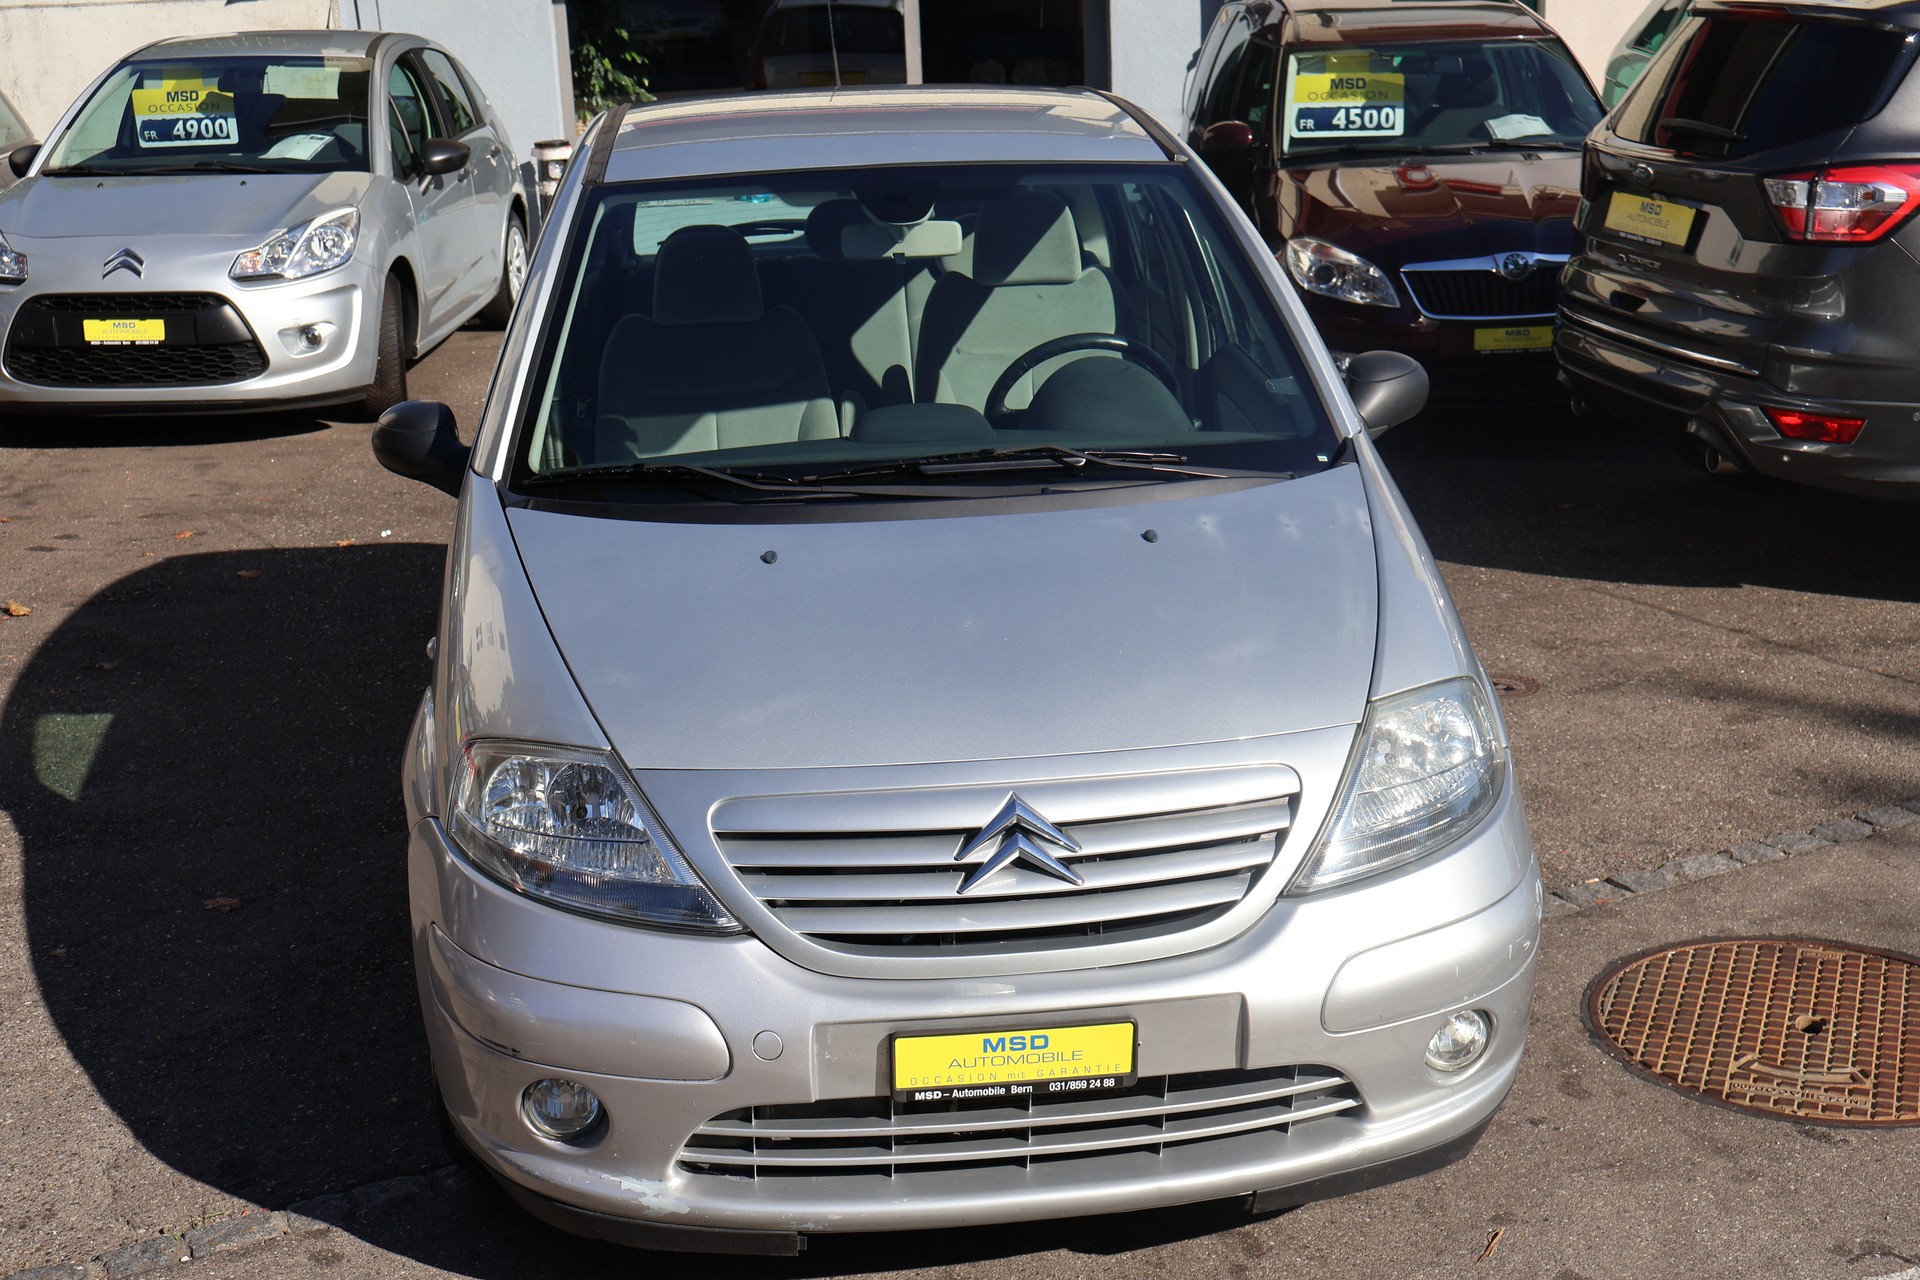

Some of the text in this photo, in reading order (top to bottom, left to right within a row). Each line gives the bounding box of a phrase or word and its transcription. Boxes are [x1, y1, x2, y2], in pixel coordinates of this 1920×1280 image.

[1330, 78, 1367, 90] MSD
[166, 90, 199, 102] MSD
[1307, 91, 1389, 101] OCCASION
[148, 102, 220, 113] OCCASION
[1300, 107, 1395, 130] FR 4500
[144, 118, 228, 140] FR 4900
[1640, 201, 1663, 215] MSD
[1505, 329, 1531, 337] MSD
[983, 1034, 1049, 1054] MSD
[948, 1050, 1083, 1069] AUTOMOBILE
[910, 1063, 1121, 1086] OCCASION mit GARANTIE
[915, 1091, 942, 1101] MSD
[952, 1086, 1006, 1098] Automobile
[1011, 1085, 1033, 1094] Bern
[1049, 1080, 1087, 1091] 031/859
[1089, 1079, 1102, 1088] 24
[1103, 1078, 1115, 1087] 88
